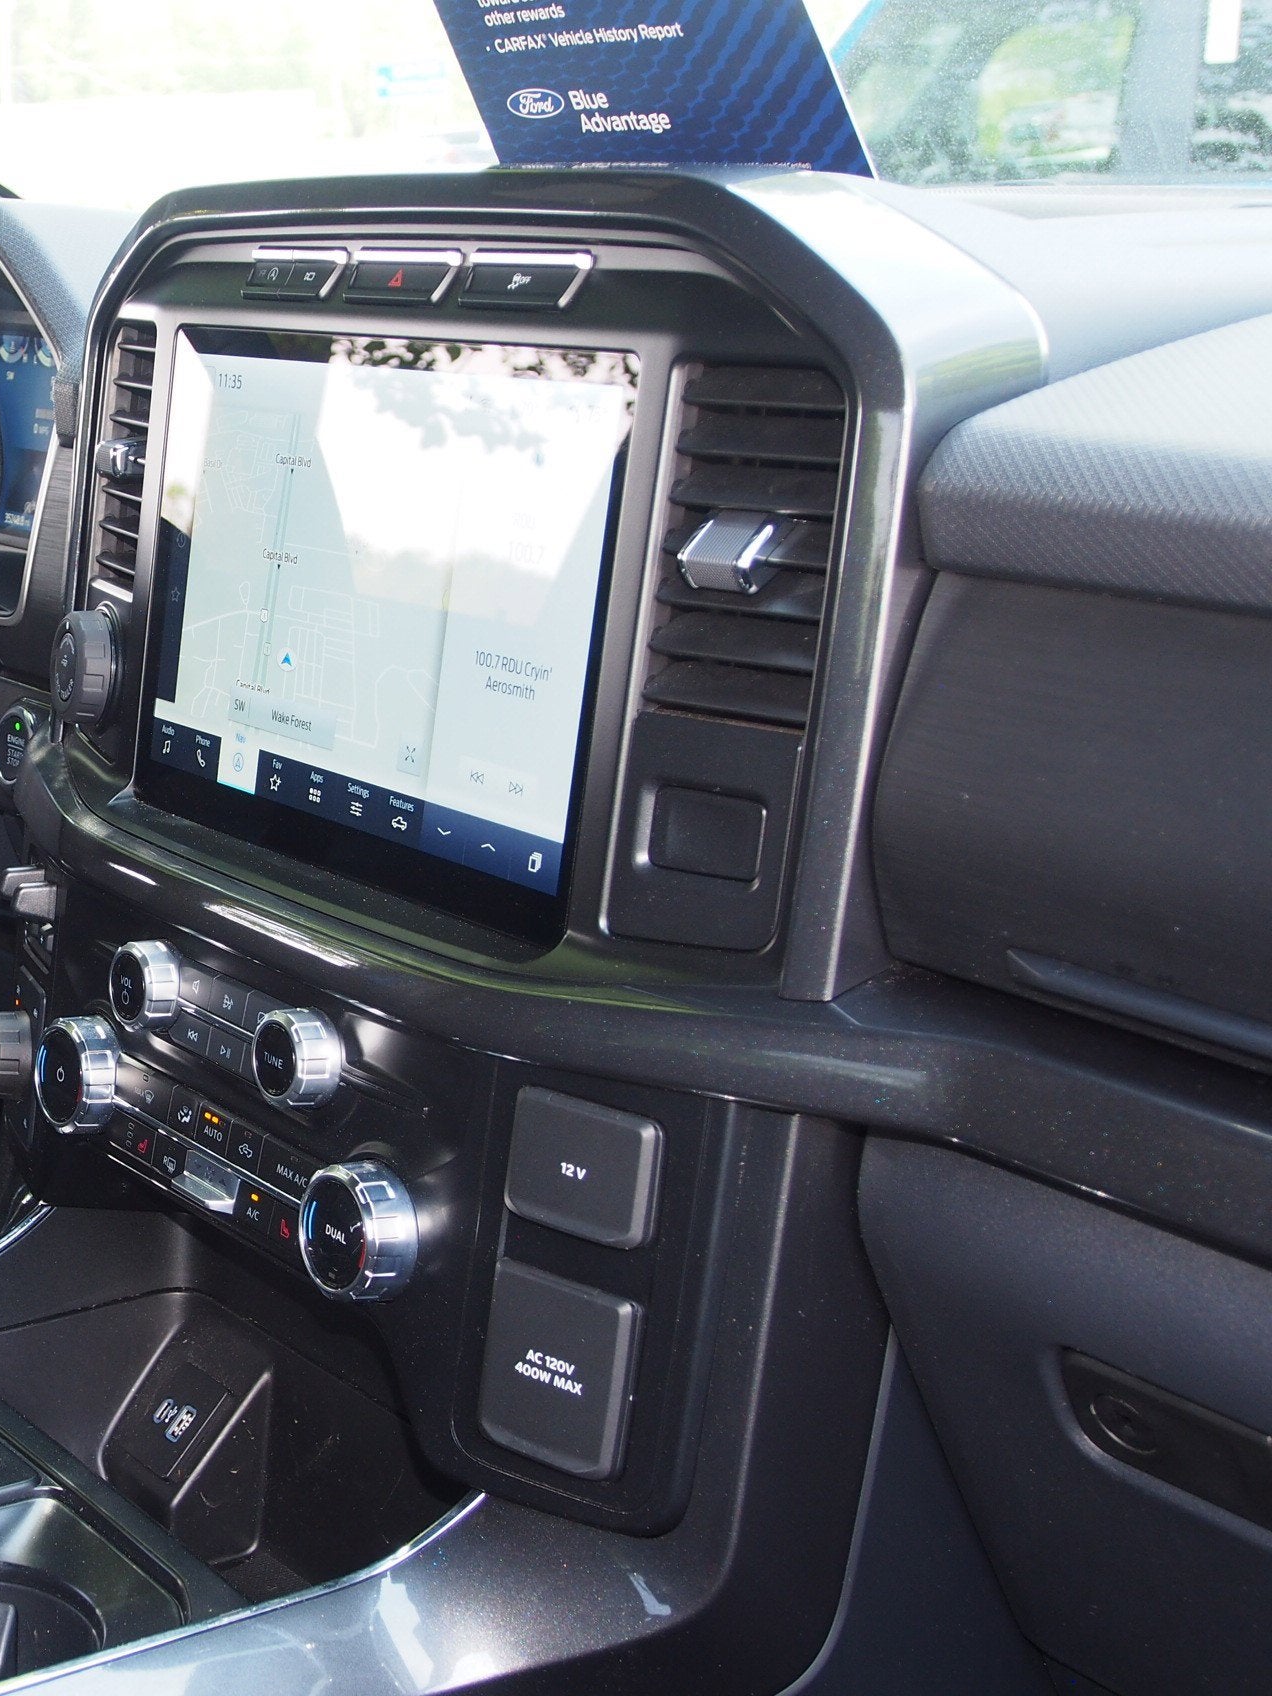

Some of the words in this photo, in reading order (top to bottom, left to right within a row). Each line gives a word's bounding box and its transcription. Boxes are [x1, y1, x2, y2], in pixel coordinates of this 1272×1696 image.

[484, 10, 515, 27] other
[516, 3, 565, 22] rewards
[548, 29, 594, 48] Vehicle
[594, 25, 638, 44] History
[638, 22, 684, 41] Report
[568, 90, 609, 111] Blue
[581, 111, 672, 134] Advantage
[219, 373, 242, 389] 11:35
[276, 453, 297, 466] Capital
[298, 457, 312, 468] Blvd
[263, 548, 284, 561] Capital
[475, 650, 500, 669] 100.7
[501, 656, 524, 675] RDU
[525, 661, 553, 681] Cryin'
[485, 675, 535, 700] Aerosmith
[234, 698, 246, 712] SW
[271, 708, 290, 726] Wake
[290, 714, 313, 732] Forest
[162, 724, 175, 736] Audio
[235, 733, 246, 744] Nav
[7, 733, 25, 746] ENGINE
[195, 734, 211, 748] Phone
[6, 748, 24, 760] START
[6, 756, 20, 767] STOP
[272, 758, 283, 770] Fav
[310, 771, 324, 784] Apps
[347, 782, 370, 799] Settings
[389, 795, 415, 812] Features
[120, 976, 132, 989] VOL
[263, 1051, 284, 1070] TUNE
[203, 1125, 223, 1142] AUTO
[276, 1163, 294, 1182] MAX
[294, 1174, 309, 1189] A/C
[246, 1206, 261, 1222] A/C
[325, 1224, 347, 1245] DUAL
[525, 1349, 544, 1366] AC
[544, 1354, 576, 1376] 120V
[514, 1361, 553, 1385] 400W
[553, 1374, 583, 1396] MAX
